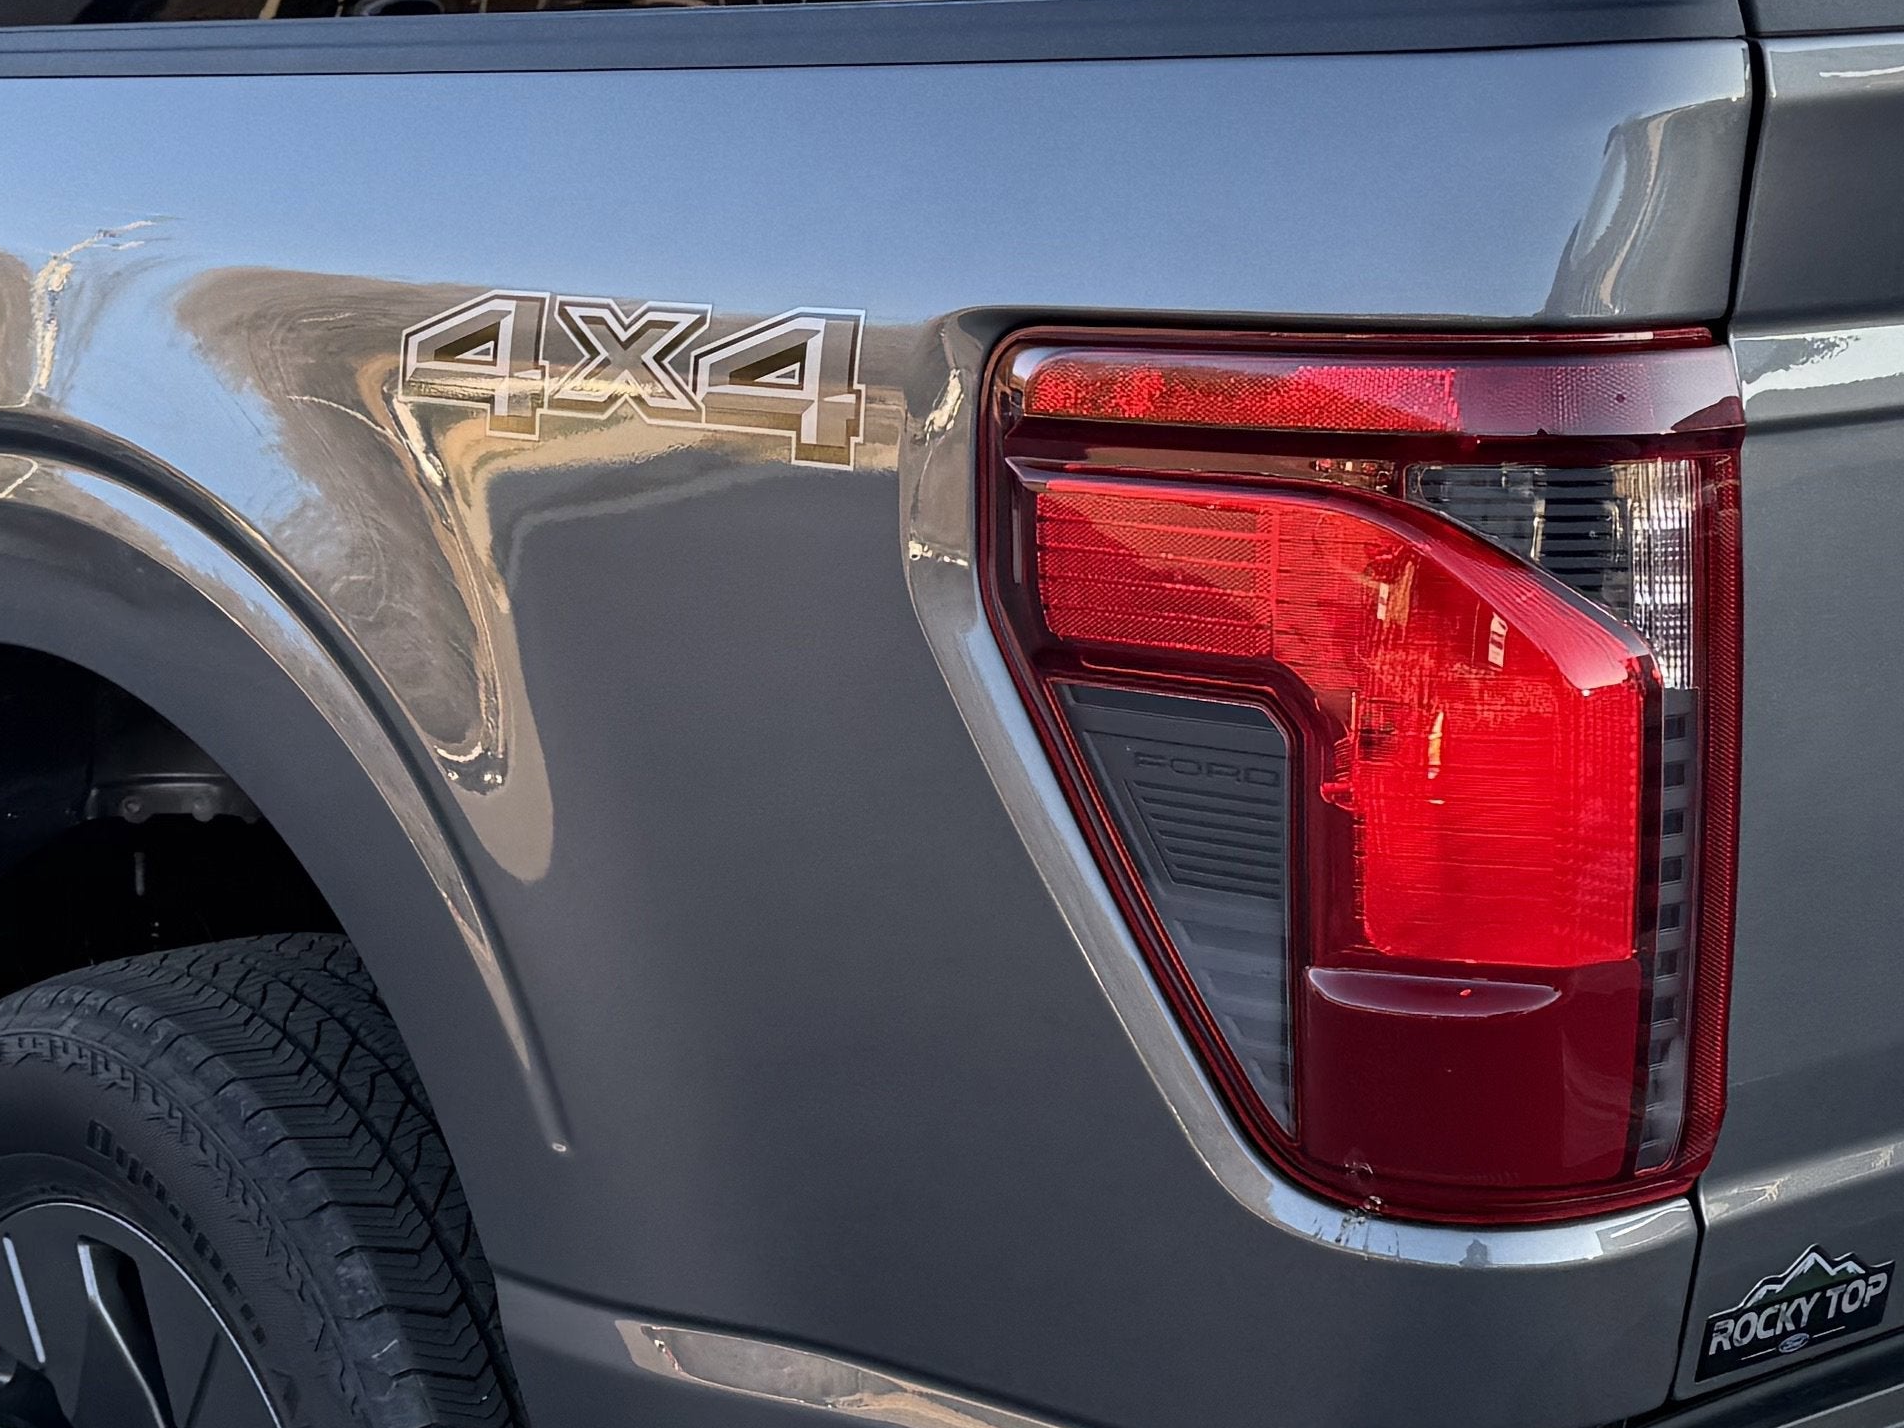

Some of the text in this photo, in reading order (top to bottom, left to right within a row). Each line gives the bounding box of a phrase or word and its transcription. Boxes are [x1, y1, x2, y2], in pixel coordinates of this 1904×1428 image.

[1134, 751, 1280, 788] FORD
[1708, 1272, 1888, 1356] ROCKY TOP
